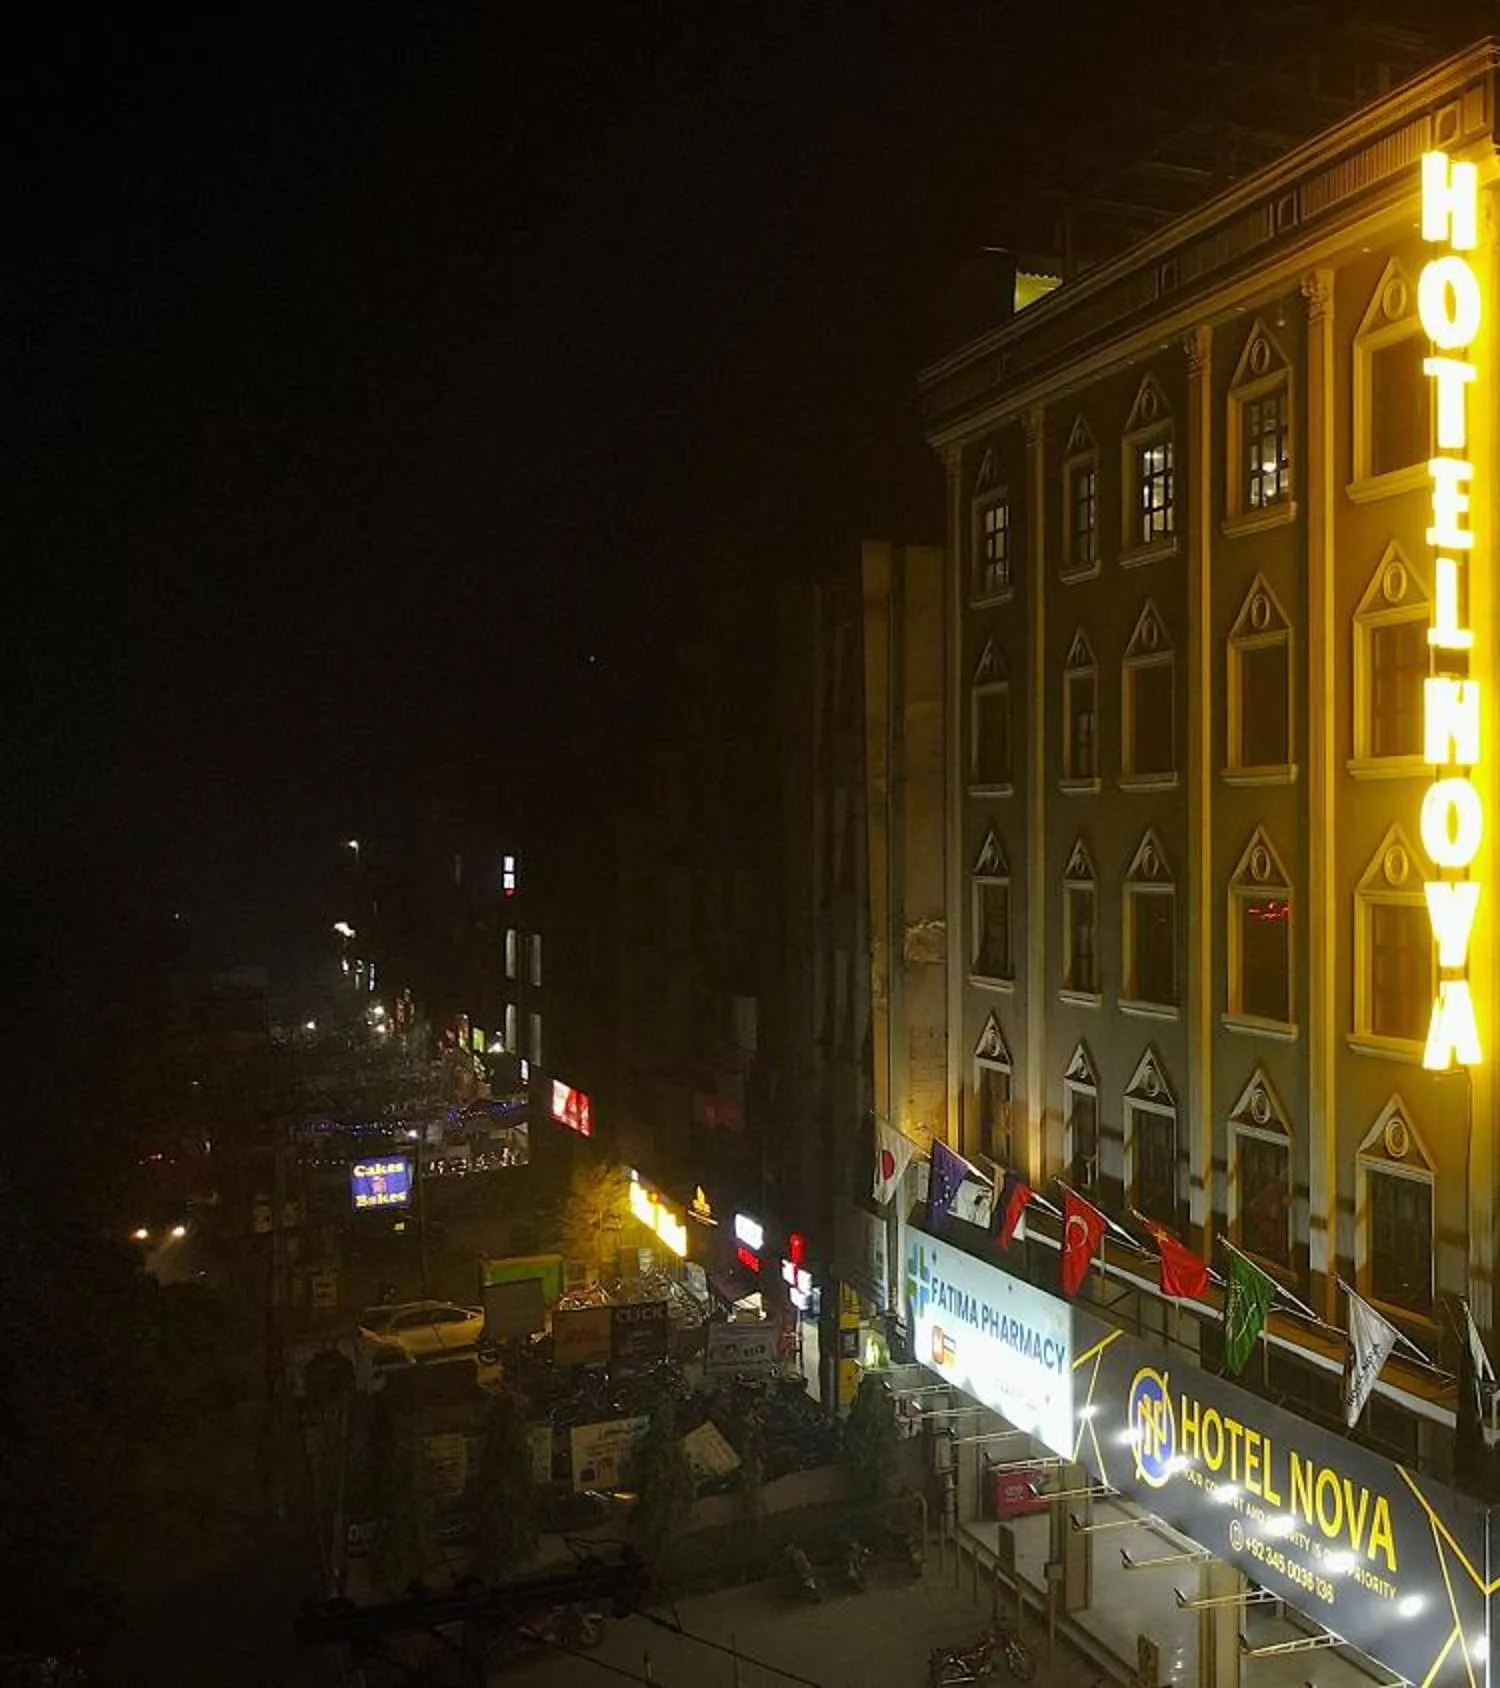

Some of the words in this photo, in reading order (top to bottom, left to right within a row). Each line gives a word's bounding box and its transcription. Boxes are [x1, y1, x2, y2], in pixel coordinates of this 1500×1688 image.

[1417, 150, 1482, 648] HOTEL
[1420, 677, 1483, 1070] NOVA
[930, 1277, 979, 1329] FATIMA
[981, 1306, 1066, 1376] PHARMACY
[1181, 1394, 1281, 1507] HOTEL
[1290, 1450, 1397, 1573] NOVA
[1287, 1560, 1315, 1592] 0036
